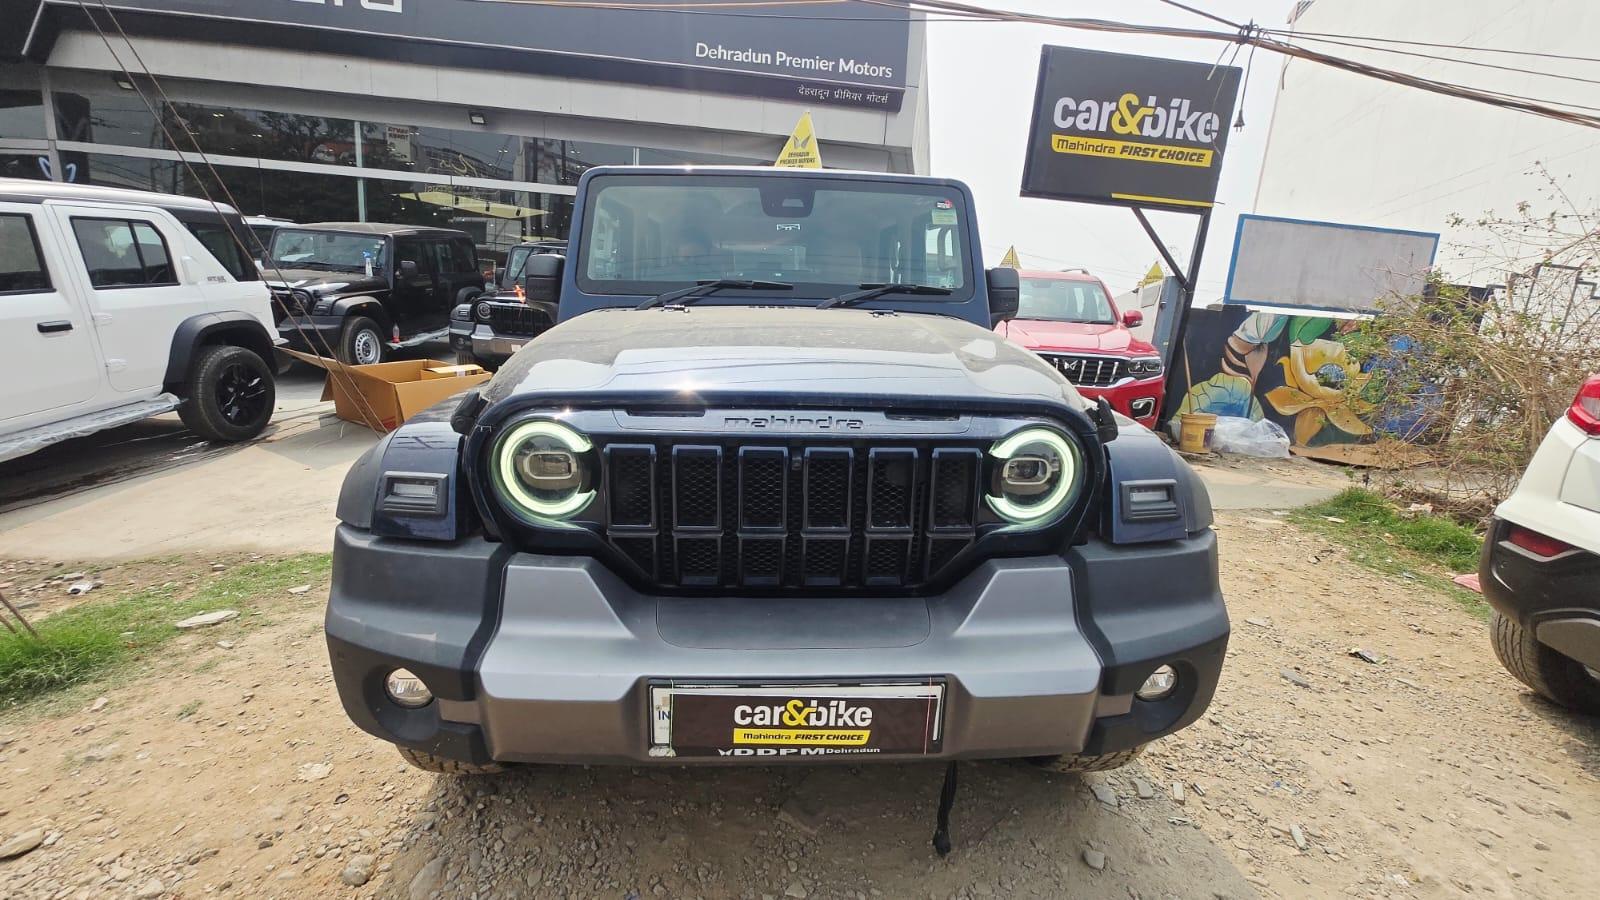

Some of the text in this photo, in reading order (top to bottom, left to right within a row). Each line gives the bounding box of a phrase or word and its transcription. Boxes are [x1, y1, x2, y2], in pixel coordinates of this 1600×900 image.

[695, 42, 893, 78] Dehradun Premier Motors
[797, 84, 829, 100] देहरादून
[834, 87, 863, 101] प्रीमियर
[1053, 92, 1220, 143] car&bike
[1056, 138, 1206, 163] Mahindra FIRST CHOICE
[724, 415, 864, 431] mahindra
[734, 699, 873, 727] car&bike
[829, 733, 864, 741] CHOICE
